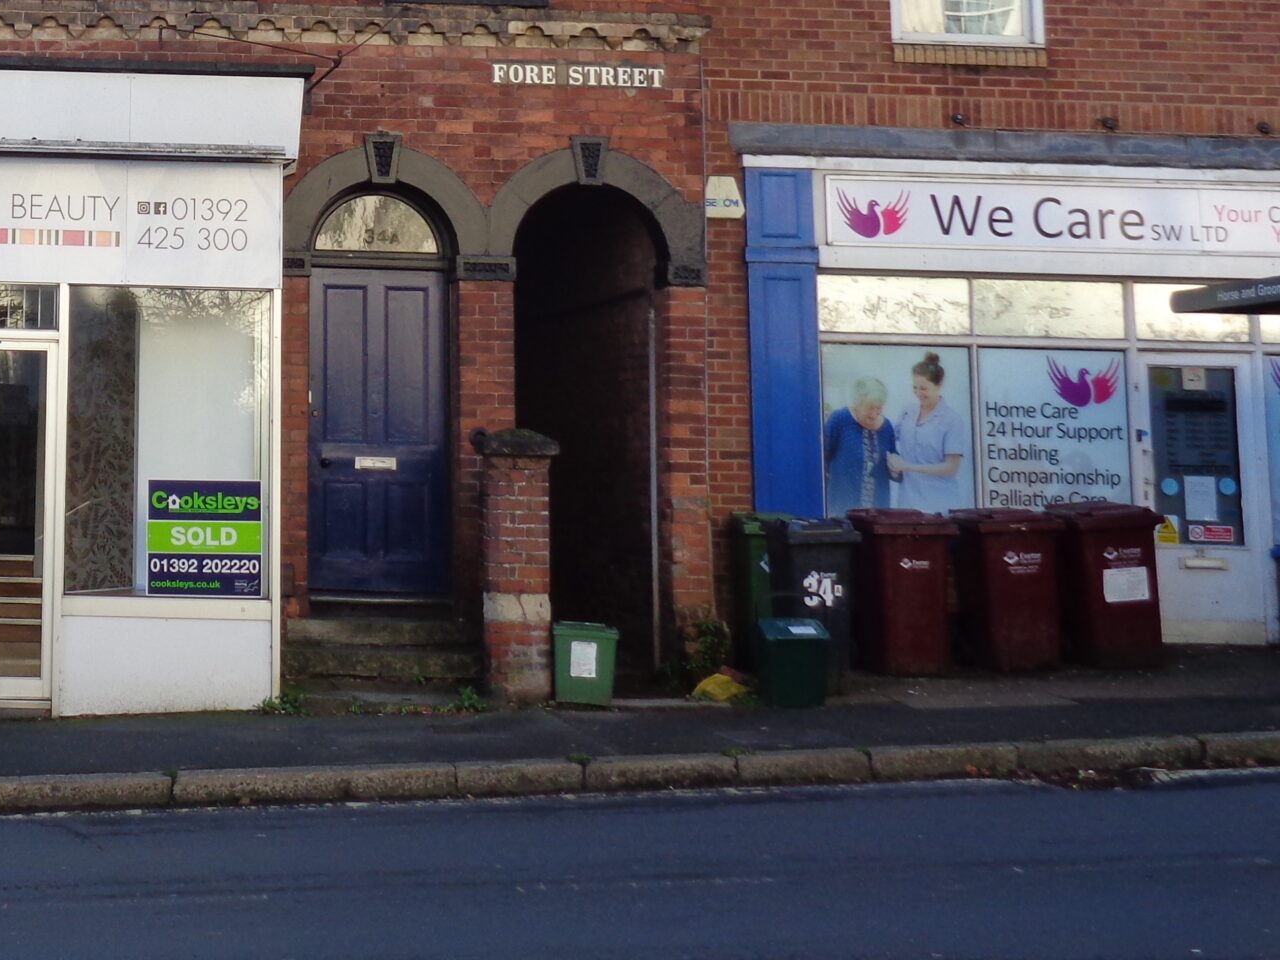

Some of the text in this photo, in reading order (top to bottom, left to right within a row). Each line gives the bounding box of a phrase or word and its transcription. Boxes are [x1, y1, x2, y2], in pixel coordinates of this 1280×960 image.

[493, 63, 665, 88] FORE STREET
[11, 193, 120, 222] BEAUTY
[171, 197, 248, 222] 01392
[930, 193, 1229, 243] We Care SW LTD
[1213, 204, 1263, 223] Your
[137, 226, 248, 252] 425 300
[985, 401, 1079, 420] Home Care
[986, 421, 1123, 443] 24 Hour Support
[987, 444, 1060, 465] Enabling
[988, 467, 1121, 489] Companionship
[151, 491, 260, 513] Cooksleys
[989, 489, 1065, 506] Palliative
[170, 526, 238, 546] SOLD
[150, 558, 260, 574] 01392 202220
[150, 579, 221, 590] cooksleys.co.uk
